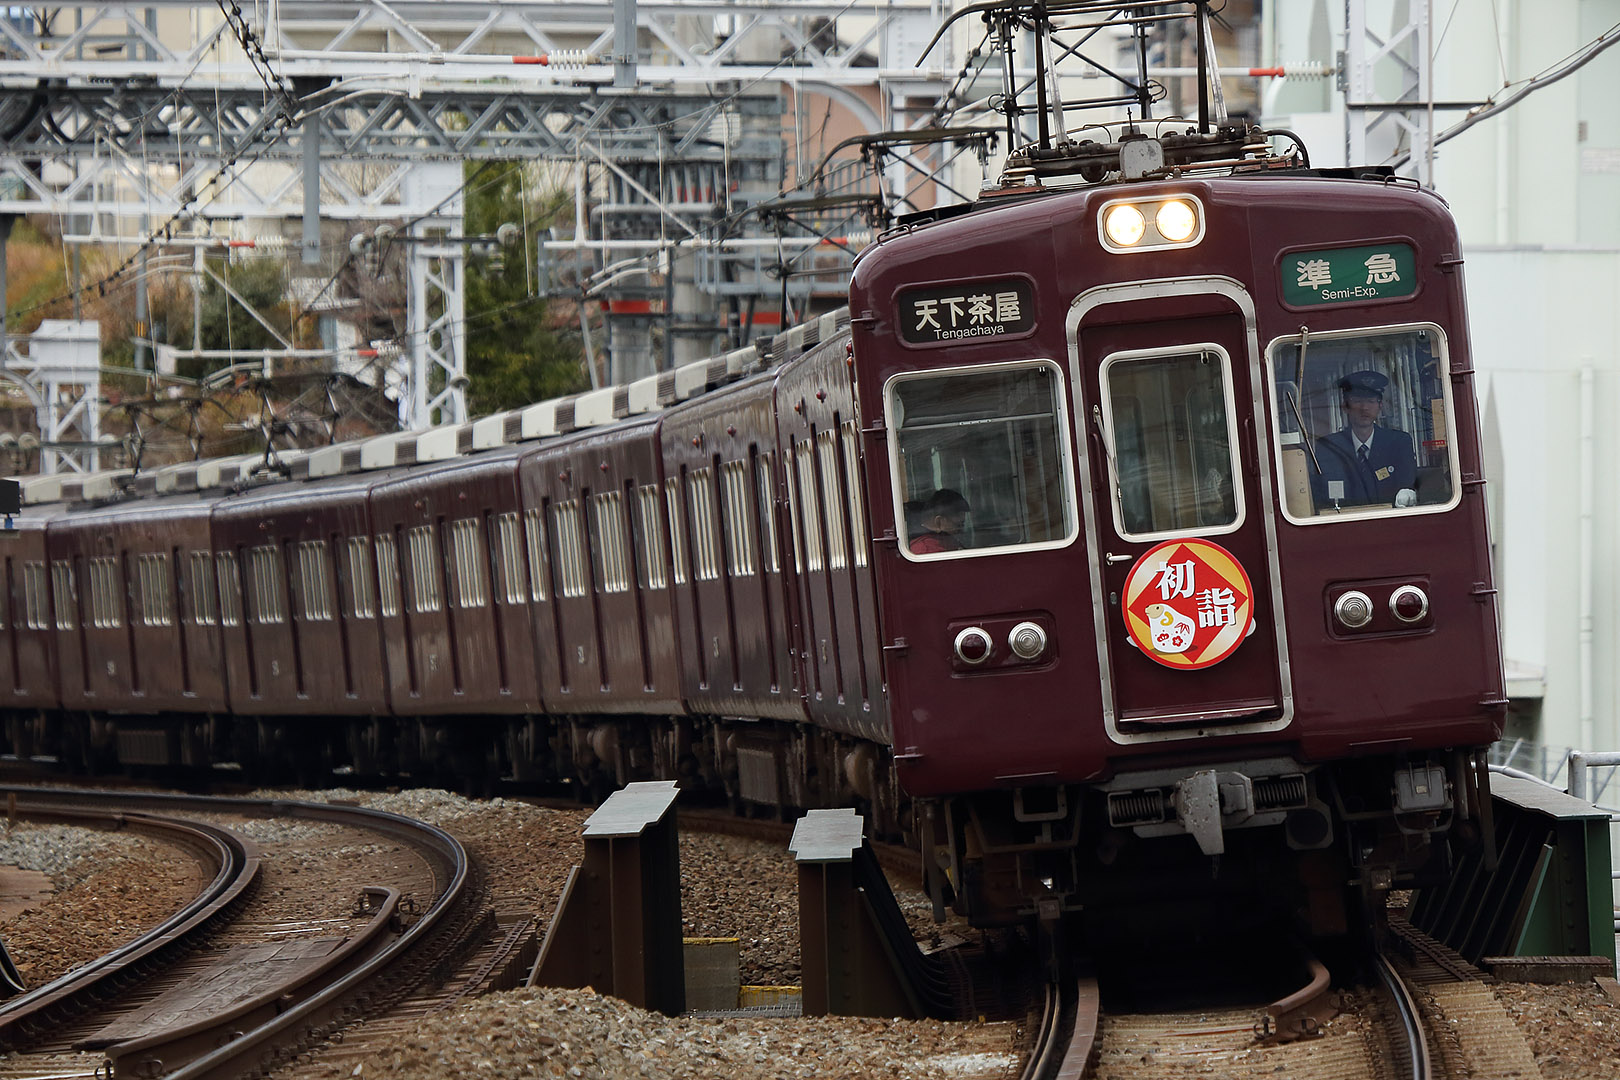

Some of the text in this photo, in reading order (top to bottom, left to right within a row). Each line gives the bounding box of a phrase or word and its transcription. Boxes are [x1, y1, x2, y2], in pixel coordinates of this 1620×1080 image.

[1297, 253, 1400, 290] 準急
[1321, 286, 1379, 300] Semi-Exp.
[914, 291, 1021, 331] 天下茶屋
[934, 324, 1005, 340] Tengachaya
